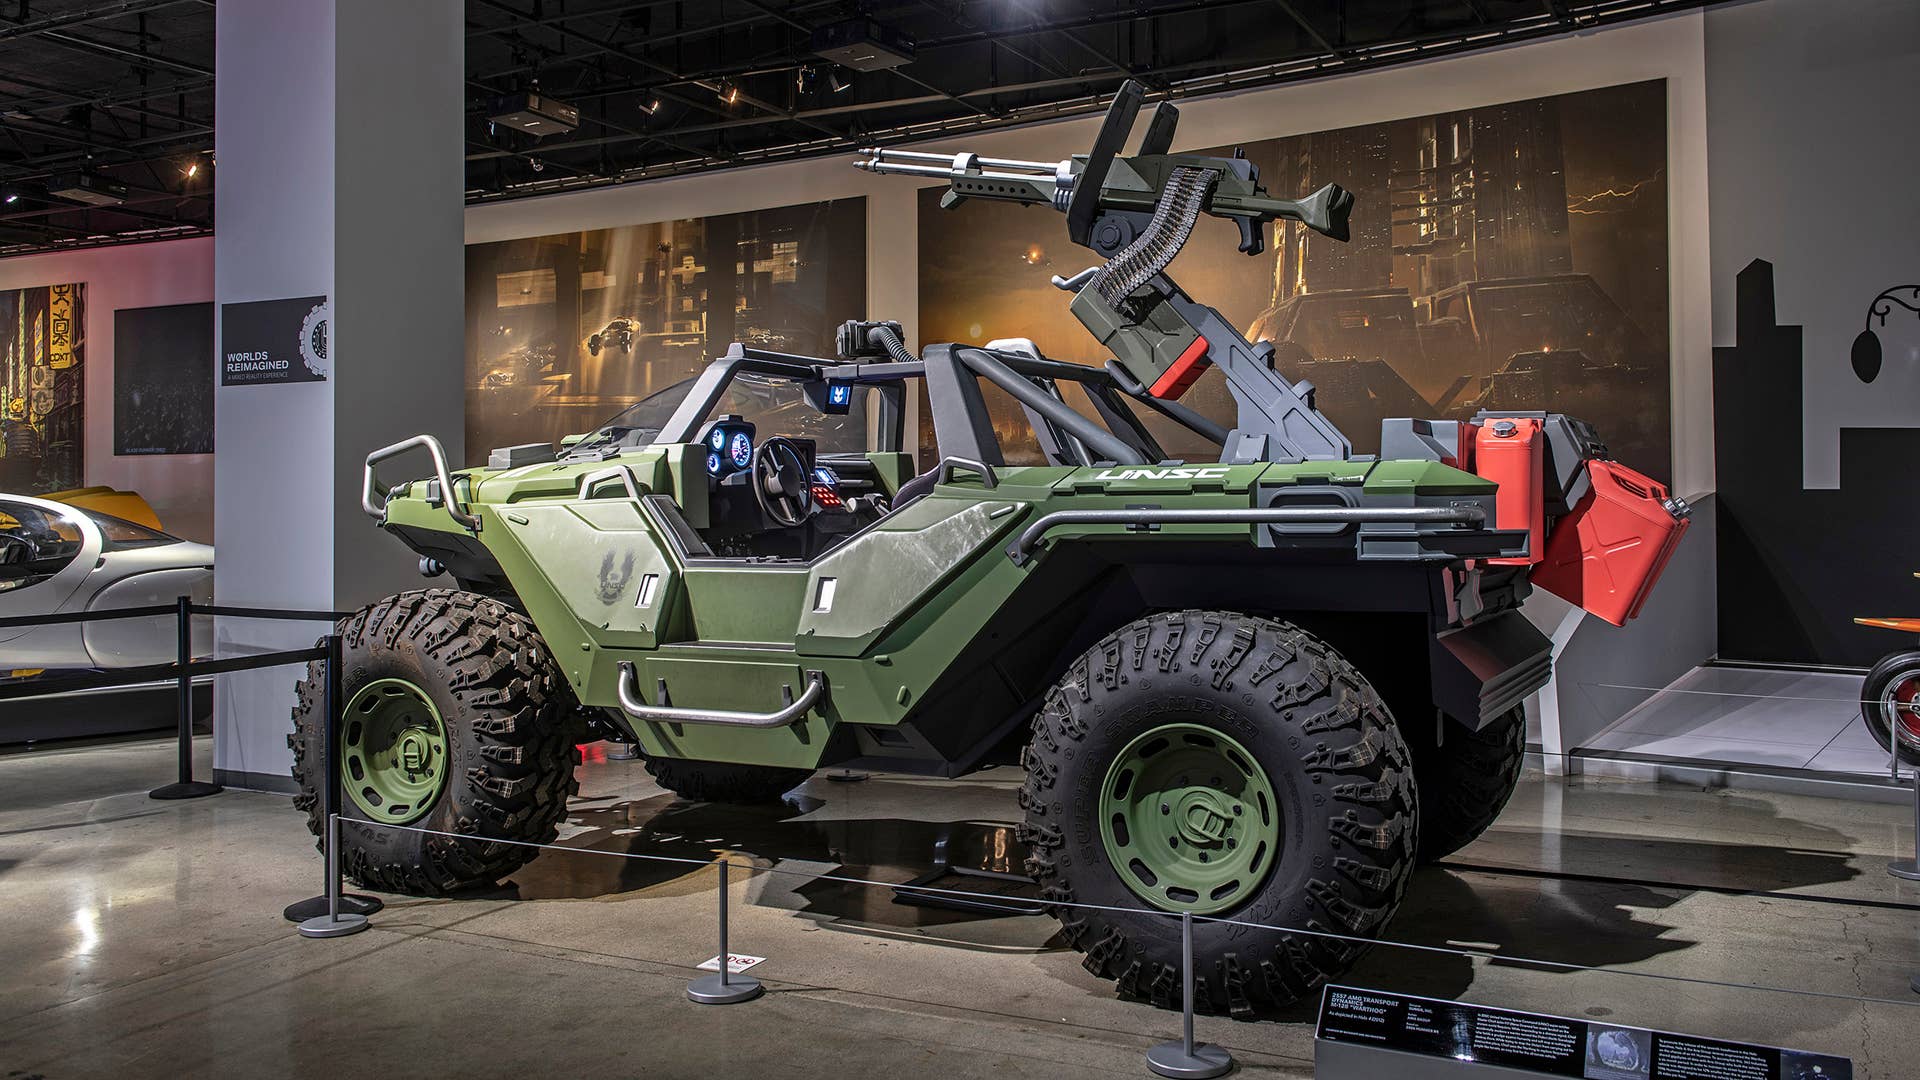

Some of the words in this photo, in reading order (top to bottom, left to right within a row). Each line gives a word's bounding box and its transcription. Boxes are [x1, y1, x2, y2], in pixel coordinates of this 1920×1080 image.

[227, 360, 289, 372] REIMAGINED
[1096, 468, 1231, 480] UNSC
[1104, 696, 1259, 740] SWAMPER
[1073, 751, 1101, 865] SUPER
[1331, 998, 1363, 1006] DYNAMICS
[1363, 996, 1399, 1007] TRANSPORT
